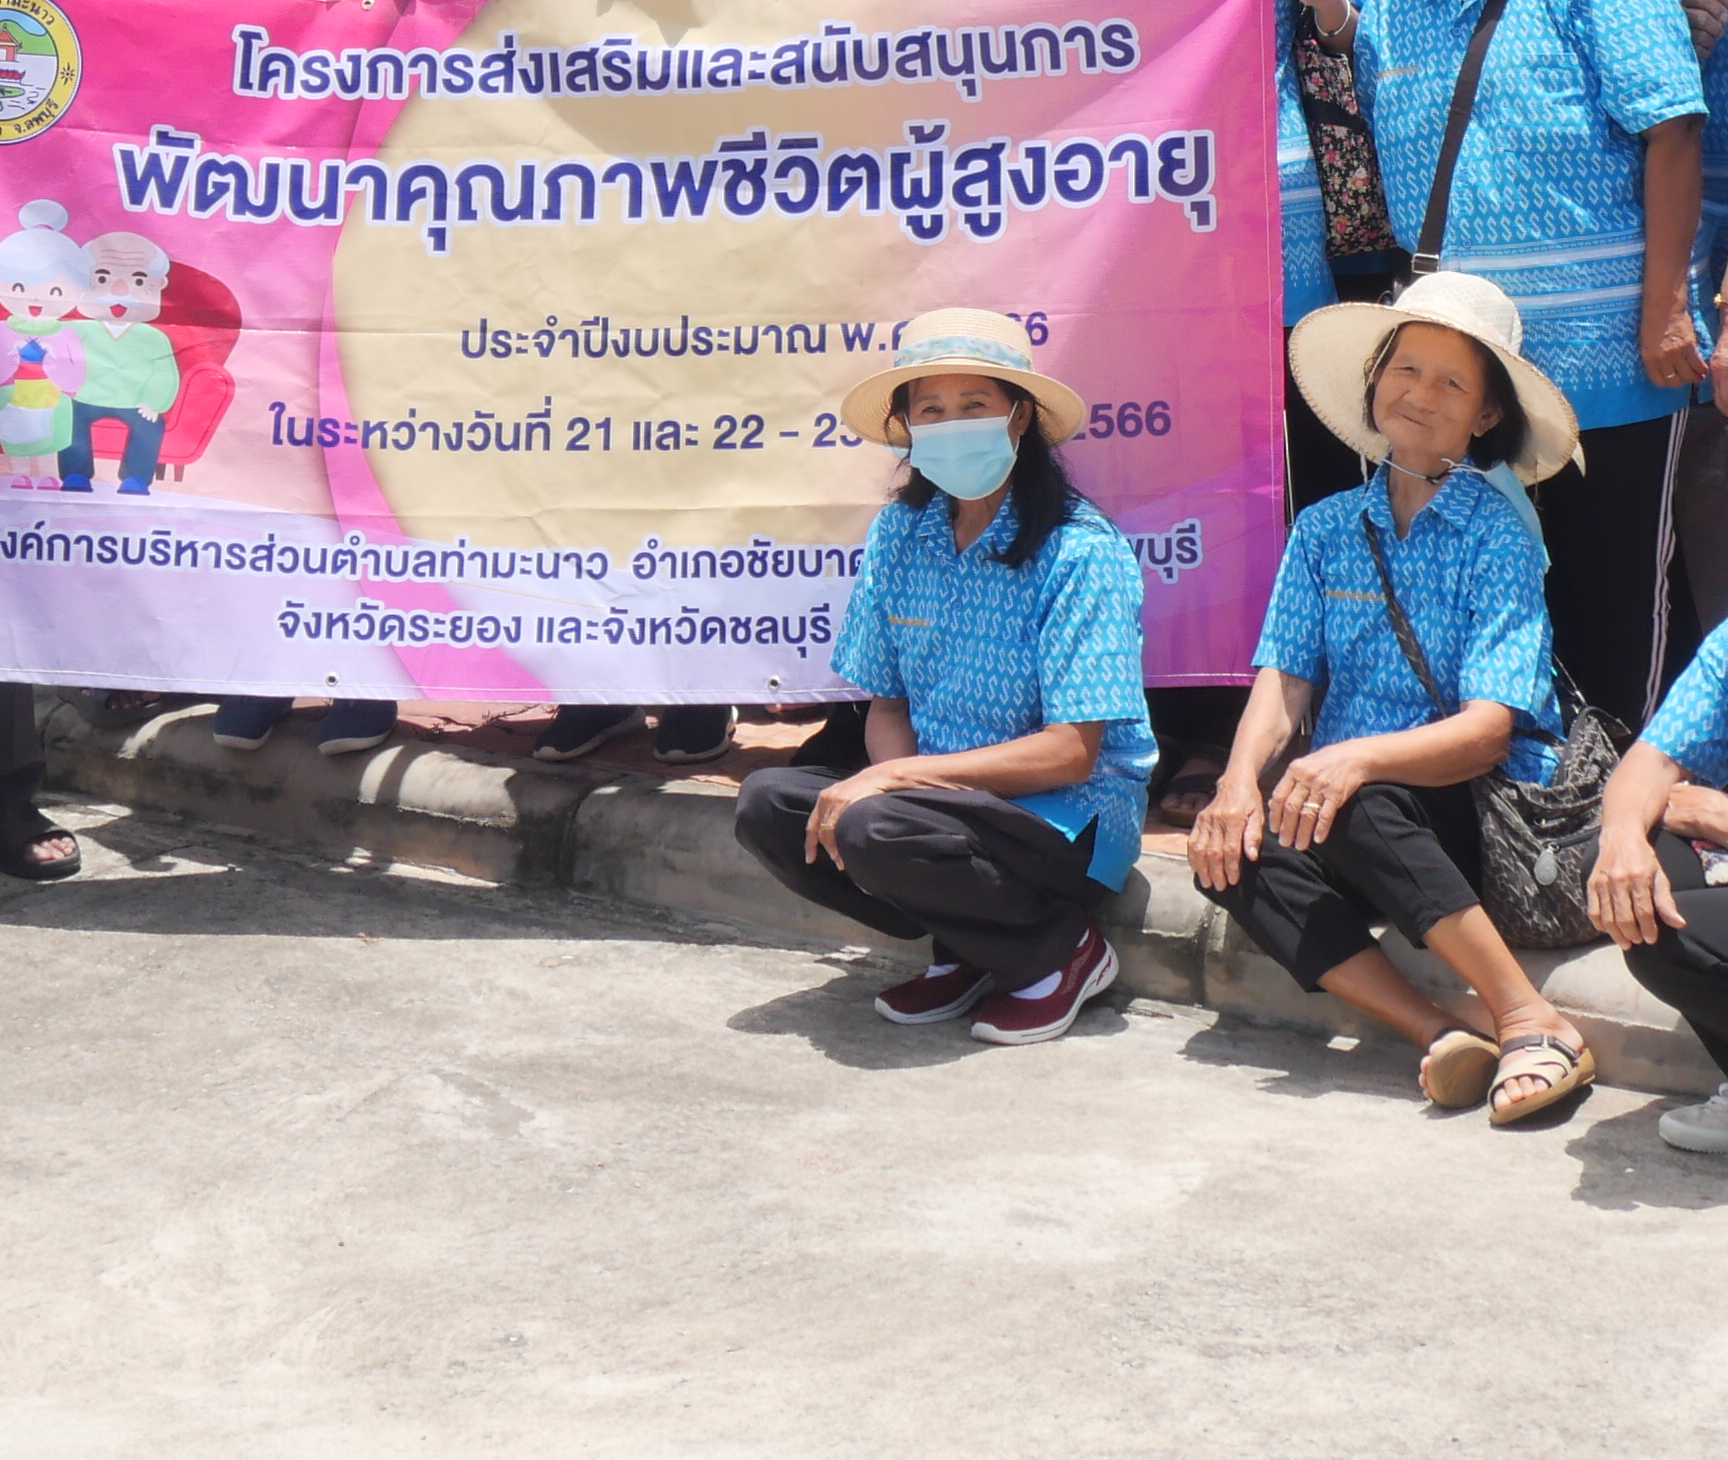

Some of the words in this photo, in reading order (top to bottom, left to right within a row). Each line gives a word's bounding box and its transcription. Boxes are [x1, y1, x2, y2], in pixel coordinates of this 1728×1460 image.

[236, 21, 1138, 98] โครงการส่งเสริมและสนับสนุนการ
[120, 123, 1212, 251] พัฒนาคุณภาพชีวิตผู้สูงอายุ
[461, 315, 828, 359] ประจำปีงบประมาณ
[269, 397, 553, 452] ในระหว่างวันที่
[566, 416, 612, 451] 21
[633, 420, 700, 451] และ
[713, 414, 765, 450] 22
[1074, 400, 1172, 441] 566
[278, 601, 522, 646] จังหวัดระยอง
[536, 603, 833, 659] และจังหวัดชลบุรี
